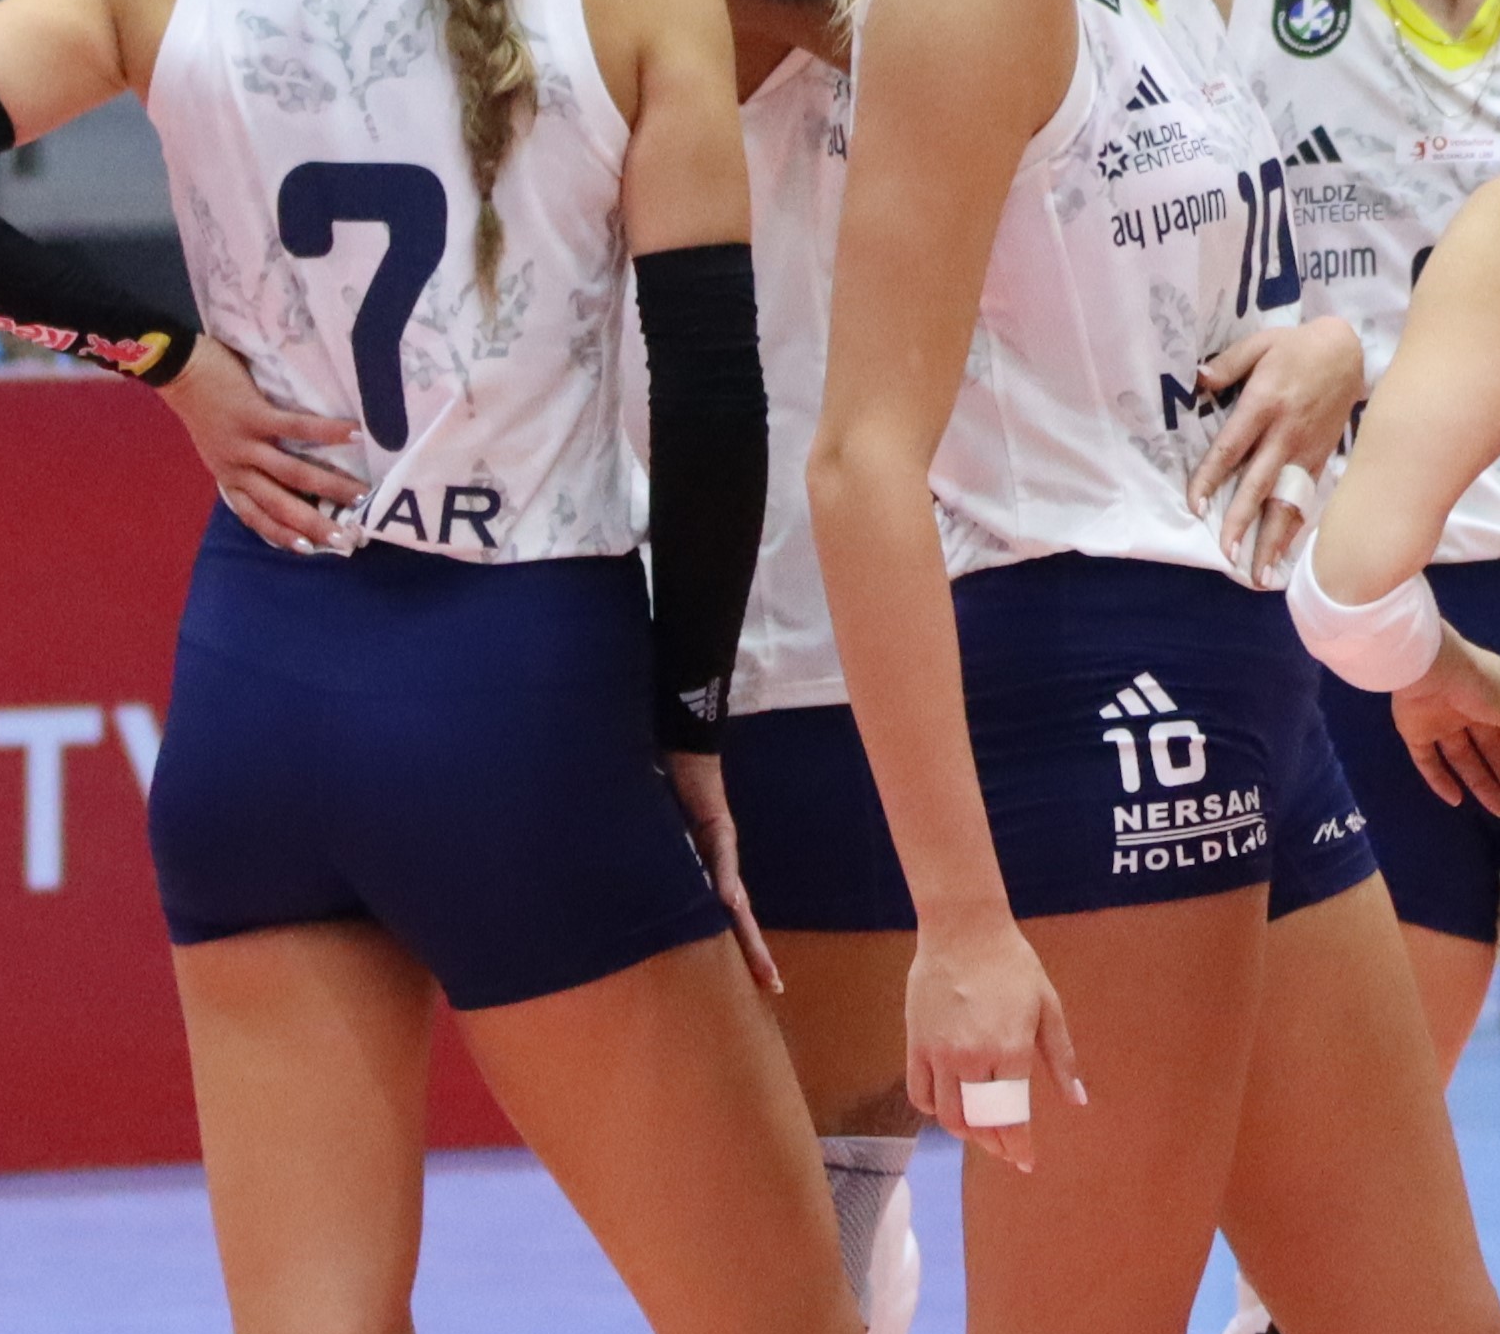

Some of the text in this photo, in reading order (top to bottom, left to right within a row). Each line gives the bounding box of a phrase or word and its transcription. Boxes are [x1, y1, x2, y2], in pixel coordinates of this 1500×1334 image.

[1127, 122, 1188, 151] YILDIZ
[1133, 137, 1214, 174] ENTEGRE
[1292, 184, 1358, 204] YILDIZ
[1293, 202, 1385, 227] ENTEGRE
[1236, 157, 1300, 319] 10
[278, 162, 448, 452] 7
[1102, 719, 1207, 794] 10
[1113, 785, 1261, 833] NERSAN
